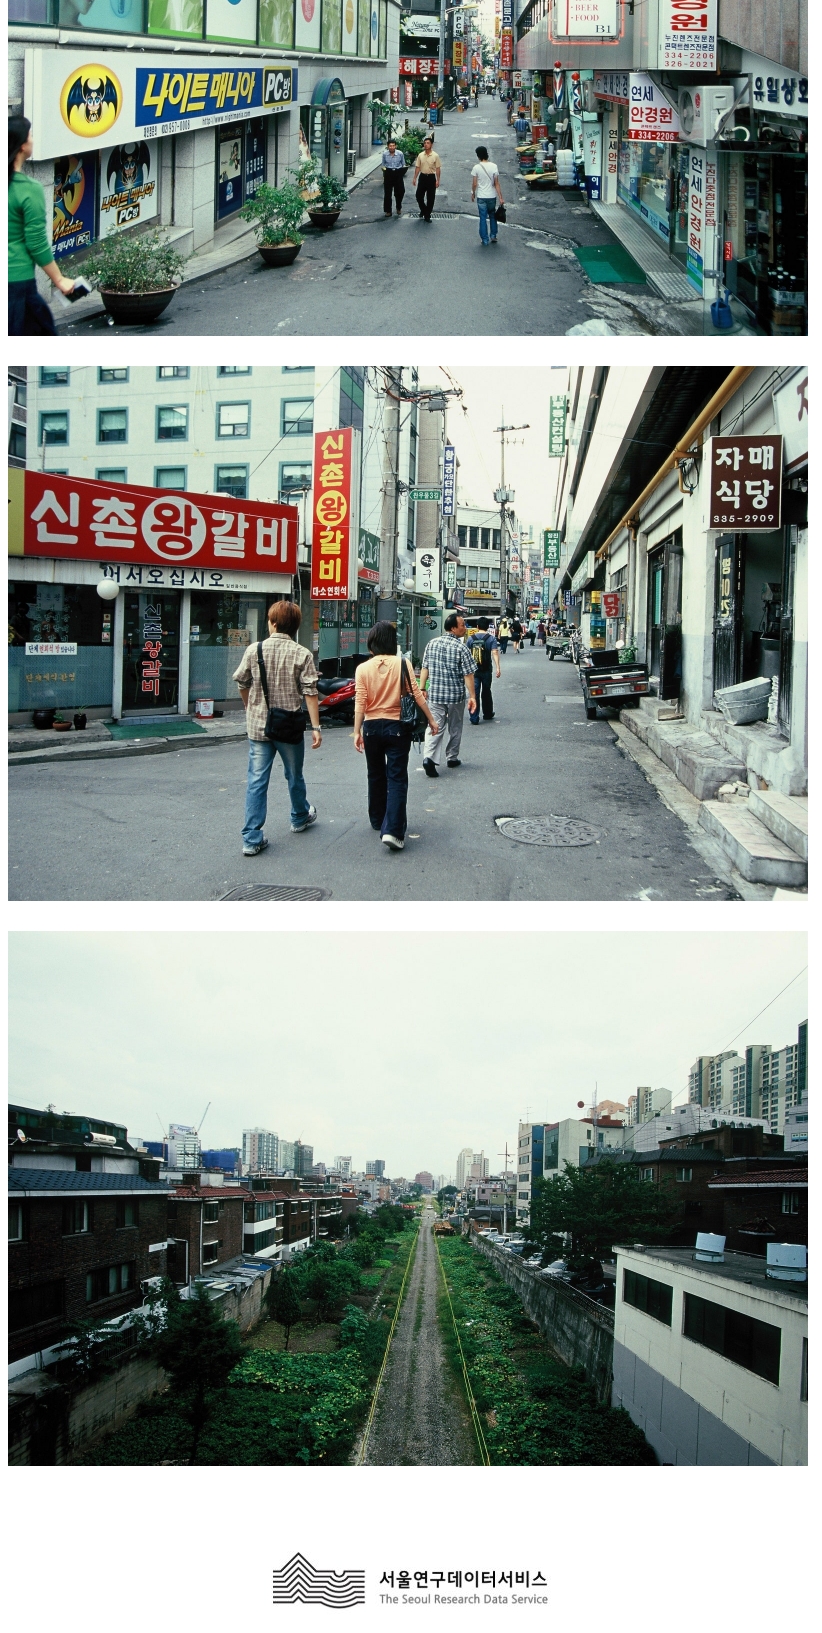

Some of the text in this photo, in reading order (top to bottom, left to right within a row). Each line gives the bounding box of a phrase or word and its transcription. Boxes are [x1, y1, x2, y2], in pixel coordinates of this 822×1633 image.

[596, 24, 612, 34] B1
[664, 52, 715, 60] 334-2206
[664, 60, 714, 68] 326-2021
[142, 72, 292, 118] 나이트 매니아 PC방
[630, 86, 654, 103] 연세
[630, 106, 673, 124] 안경원
[630, 130, 675, 141] T 334-2206
[102, 180, 156, 213] 나이트 매니아
[118, 204, 140, 225] PC방
[716, 445, 774, 471] 자매
[716, 478, 775, 510] 식당
[316, 434, 347, 583] 신촌왕갈비
[714, 514, 775, 523] 335-2909
[30, 489, 289, 563] 신촌왕갈비
[547, 539, 558, 560] 부동산
[104, 566, 225, 587] 어서오십시오
[603, 593, 620, 618] 닭
[28, 644, 39, 653] 단체
[142, 604, 162, 696] 신촌왕갈비
